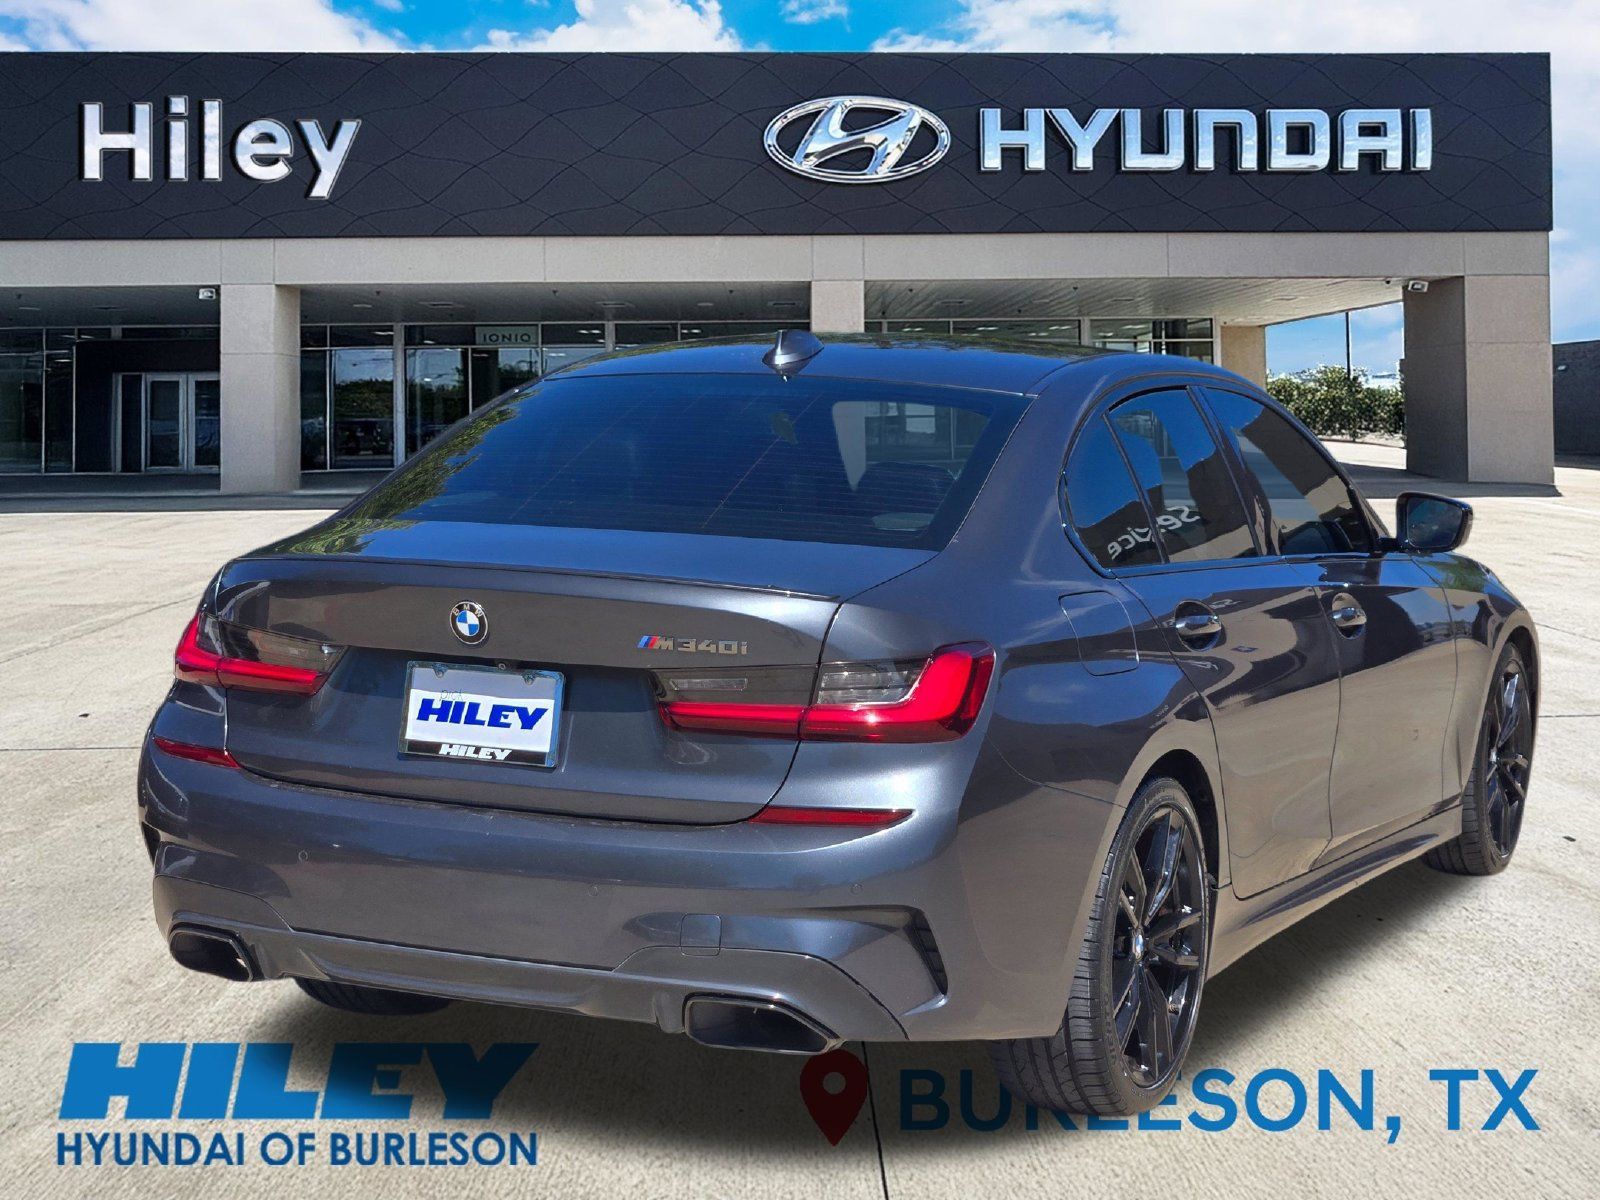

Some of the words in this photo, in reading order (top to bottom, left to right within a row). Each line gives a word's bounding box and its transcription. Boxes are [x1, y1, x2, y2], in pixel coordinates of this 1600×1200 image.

[80, 95, 361, 199] Hiley
[979, 108, 1433, 171] HYUNDAI
[451, 602, 484, 618] BMW
[650, 635, 748, 656] M340i
[416, 698, 548, 730] HILEY
[438, 744, 513, 761] HILEY
